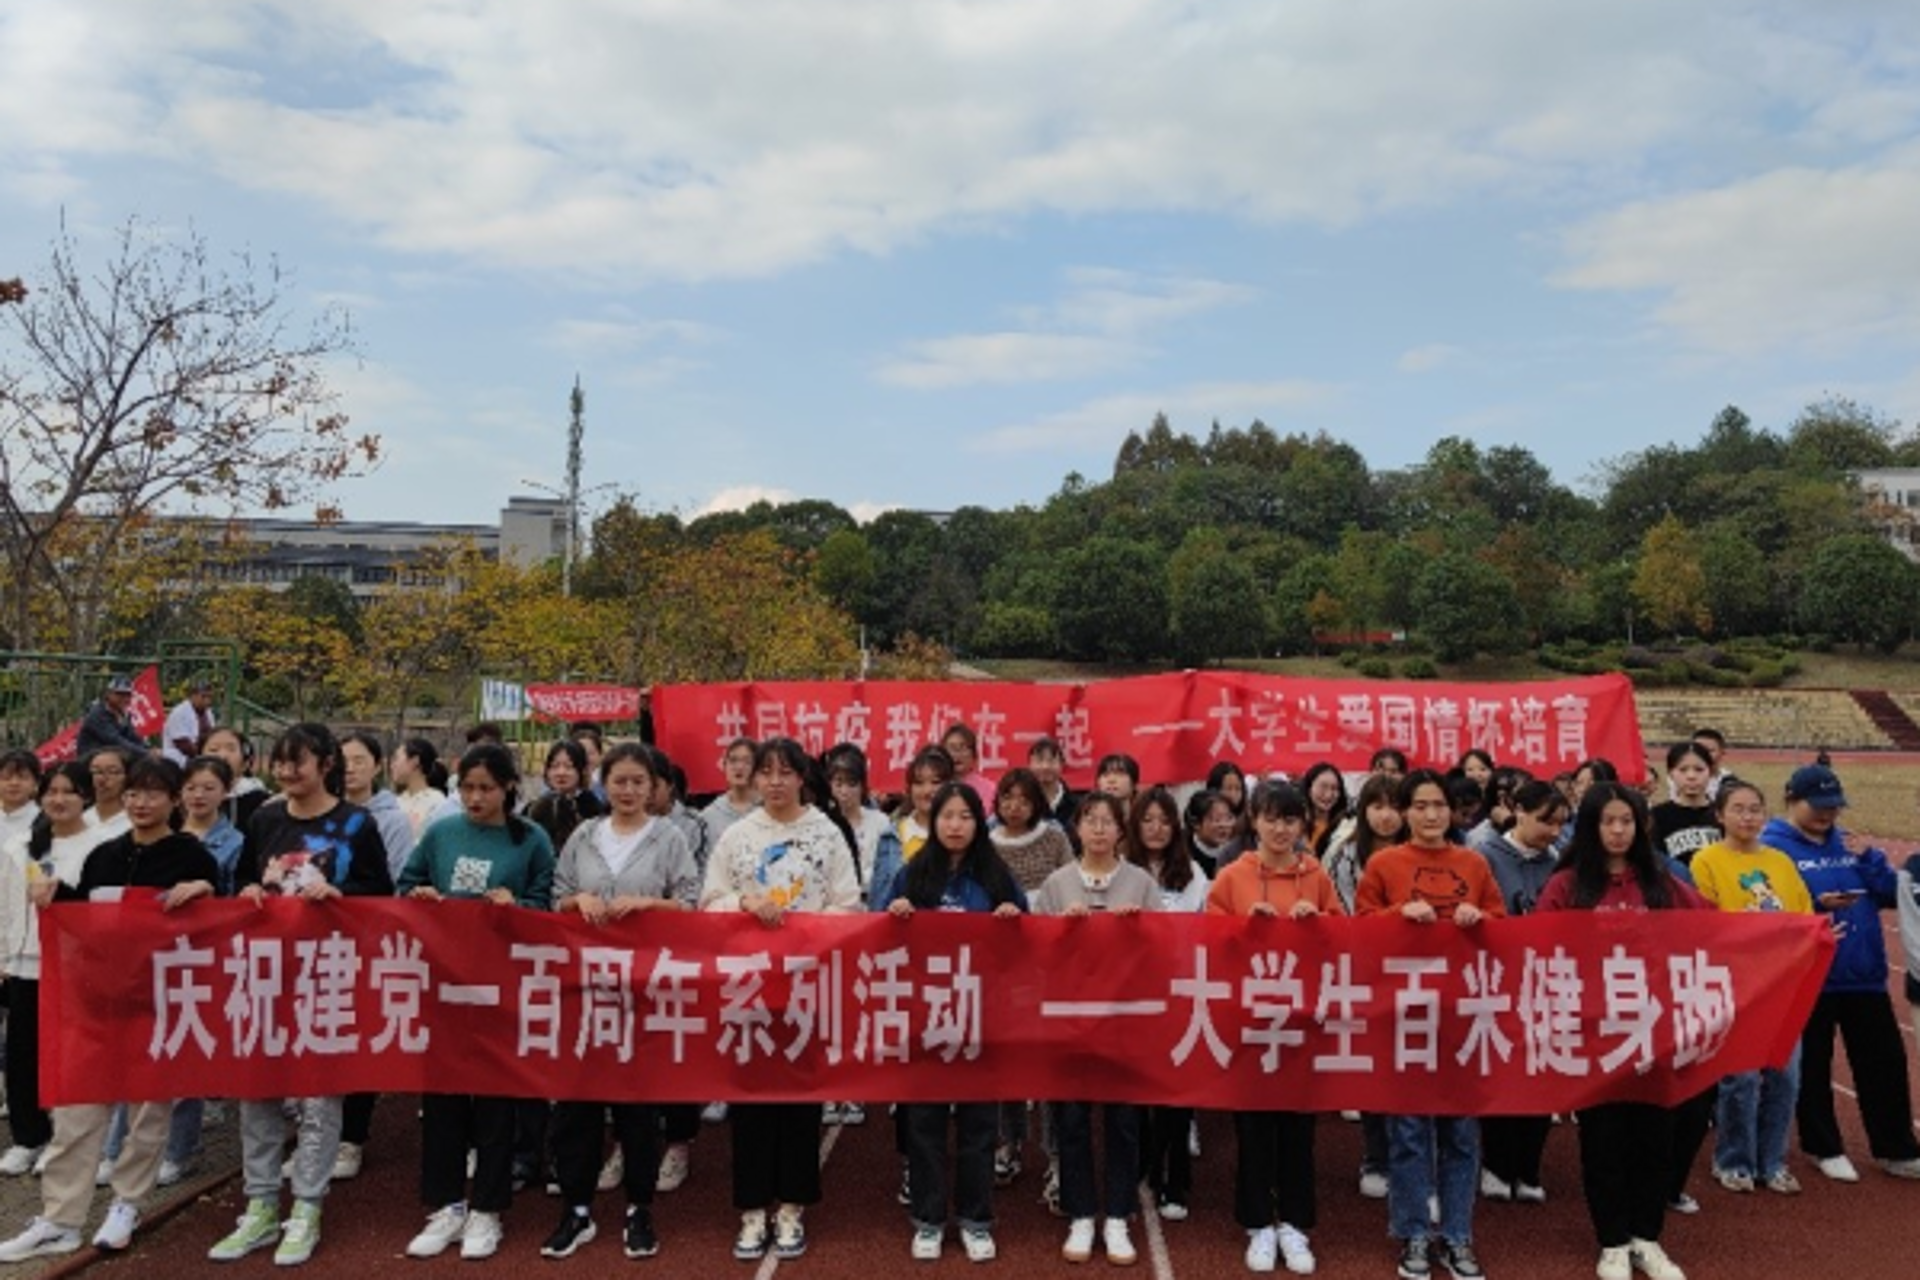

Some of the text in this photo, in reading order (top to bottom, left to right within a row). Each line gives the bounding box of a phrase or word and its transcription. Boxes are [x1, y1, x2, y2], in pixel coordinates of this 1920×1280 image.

[148, 930, 983, 1066] 庆祝建党一百周年系列活动
